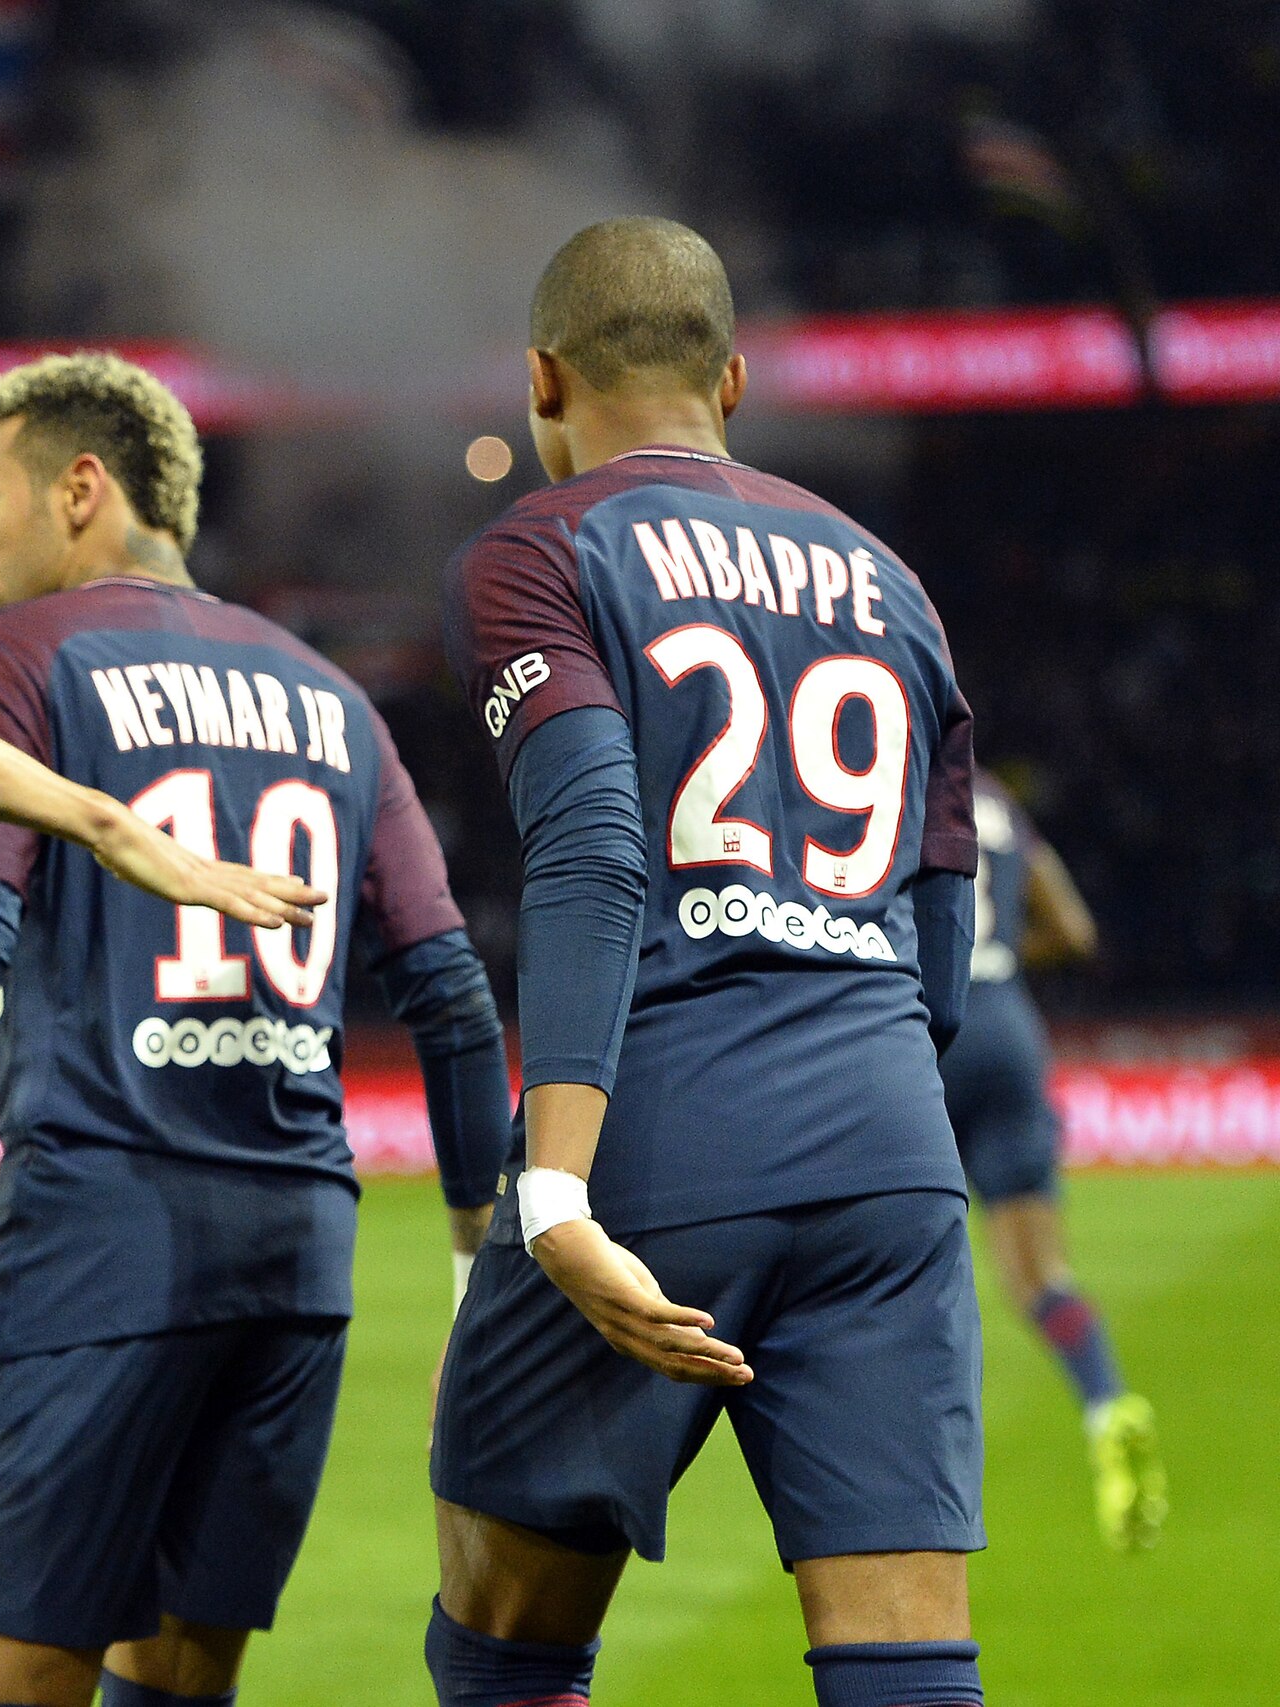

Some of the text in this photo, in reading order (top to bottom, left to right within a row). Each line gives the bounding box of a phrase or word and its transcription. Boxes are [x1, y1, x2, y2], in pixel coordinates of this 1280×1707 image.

[632, 518, 886, 637] MBAPPÉ
[91, 662, 352, 774] NEYMAR JR
[485, 652, 551, 738] QNB
[643, 623, 911, 899] 29
[128, 768, 340, 1010] 10
